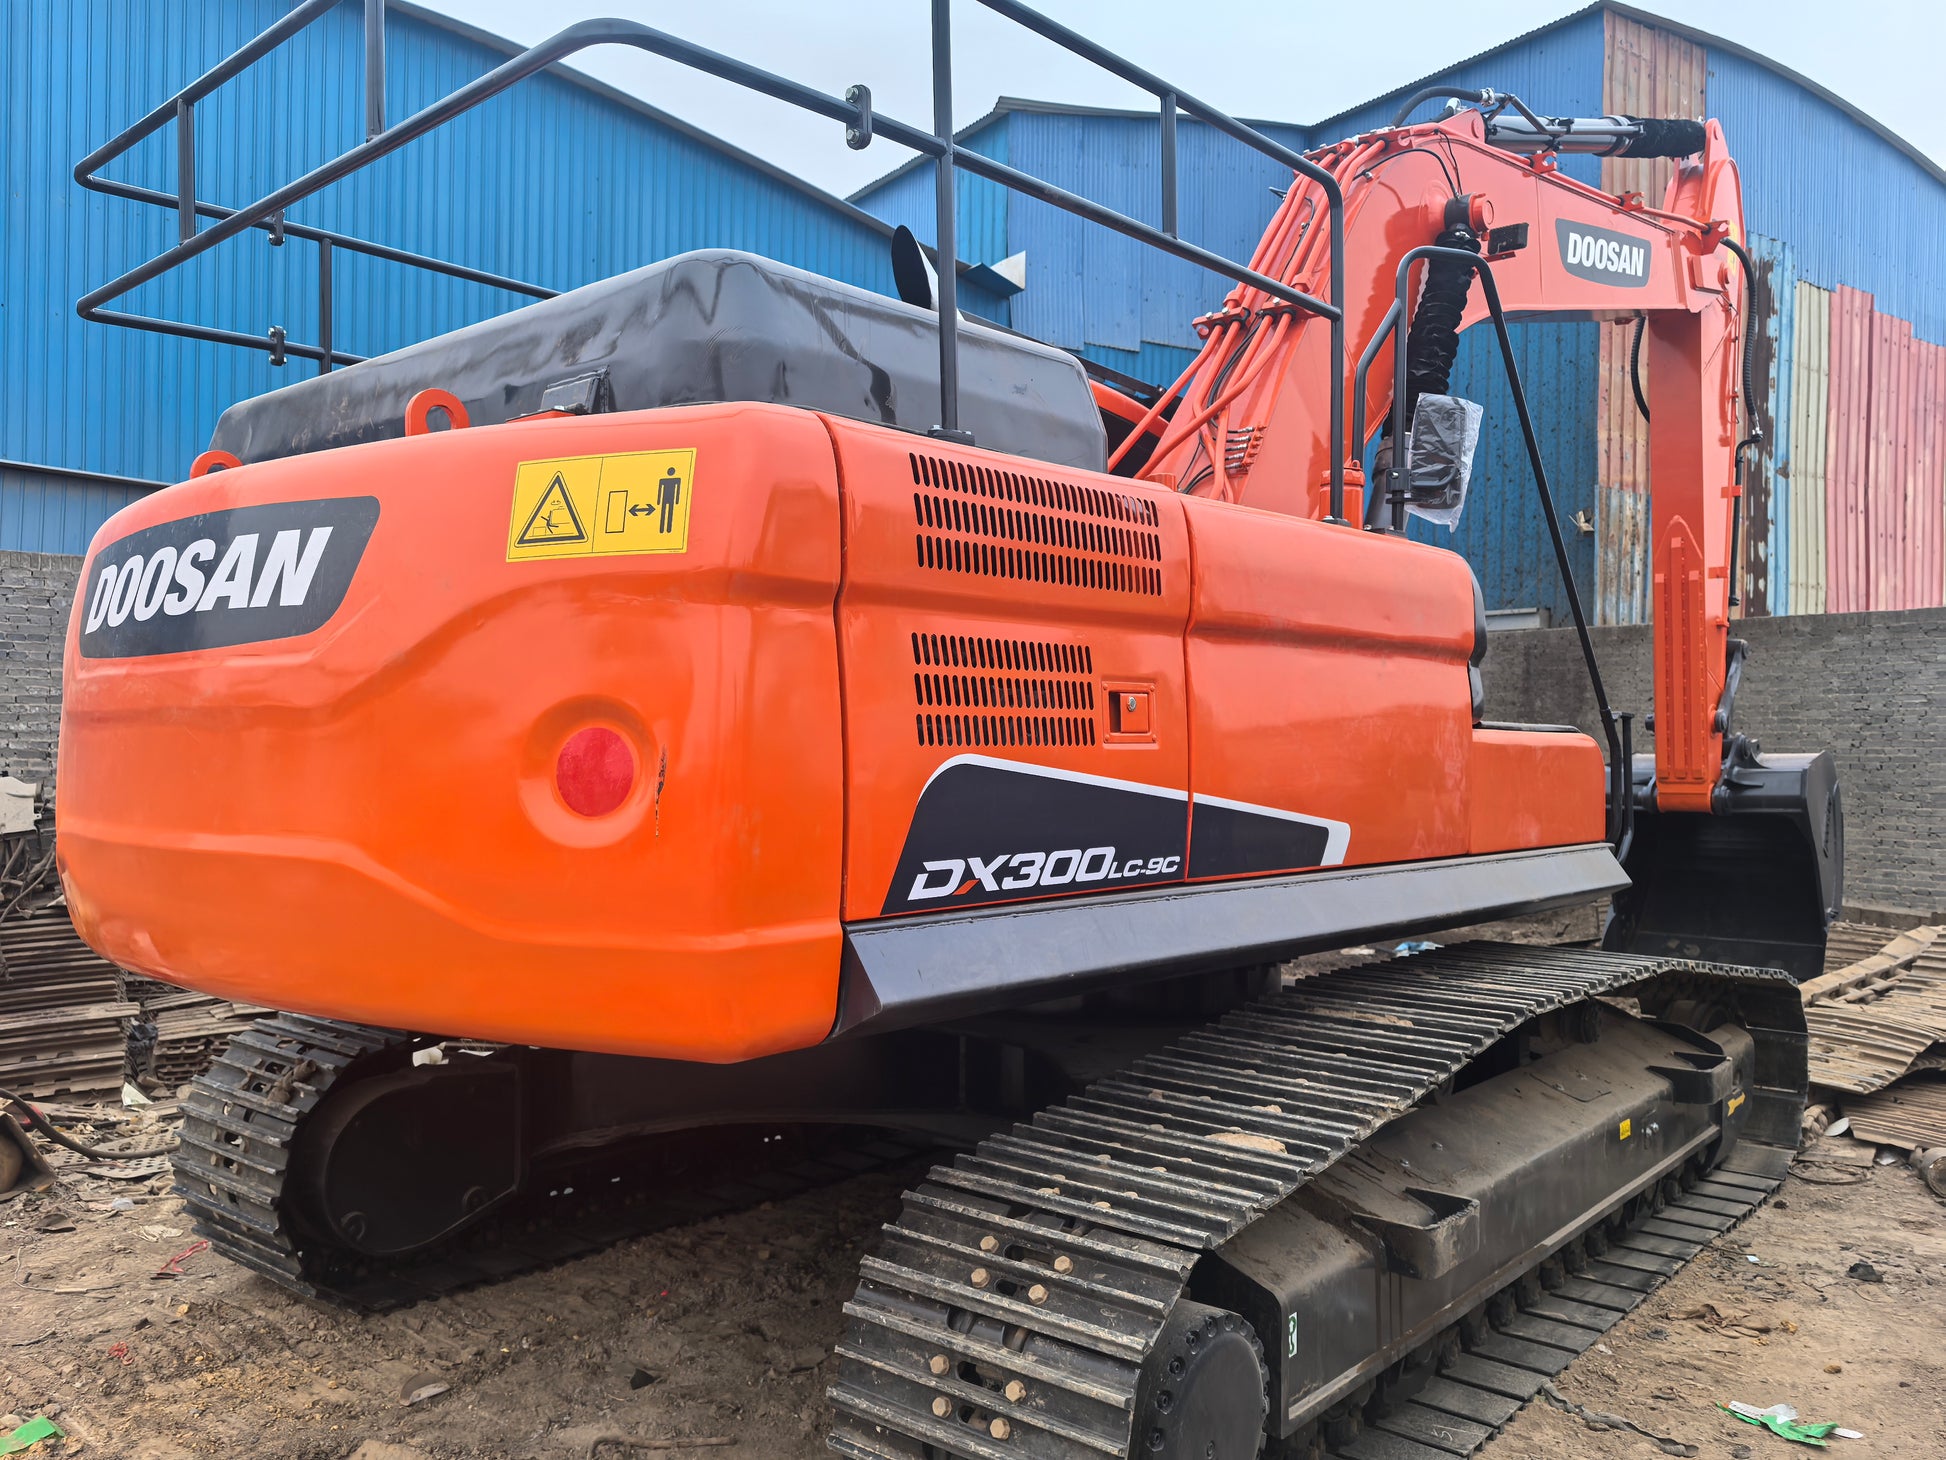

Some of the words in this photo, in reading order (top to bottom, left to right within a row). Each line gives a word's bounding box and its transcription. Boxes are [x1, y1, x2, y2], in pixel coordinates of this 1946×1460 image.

[1567, 232, 1644, 277] DOOSAN
[84, 525, 334, 636] DOOSAN
[907, 846, 1181, 901] DX300LC-9C
